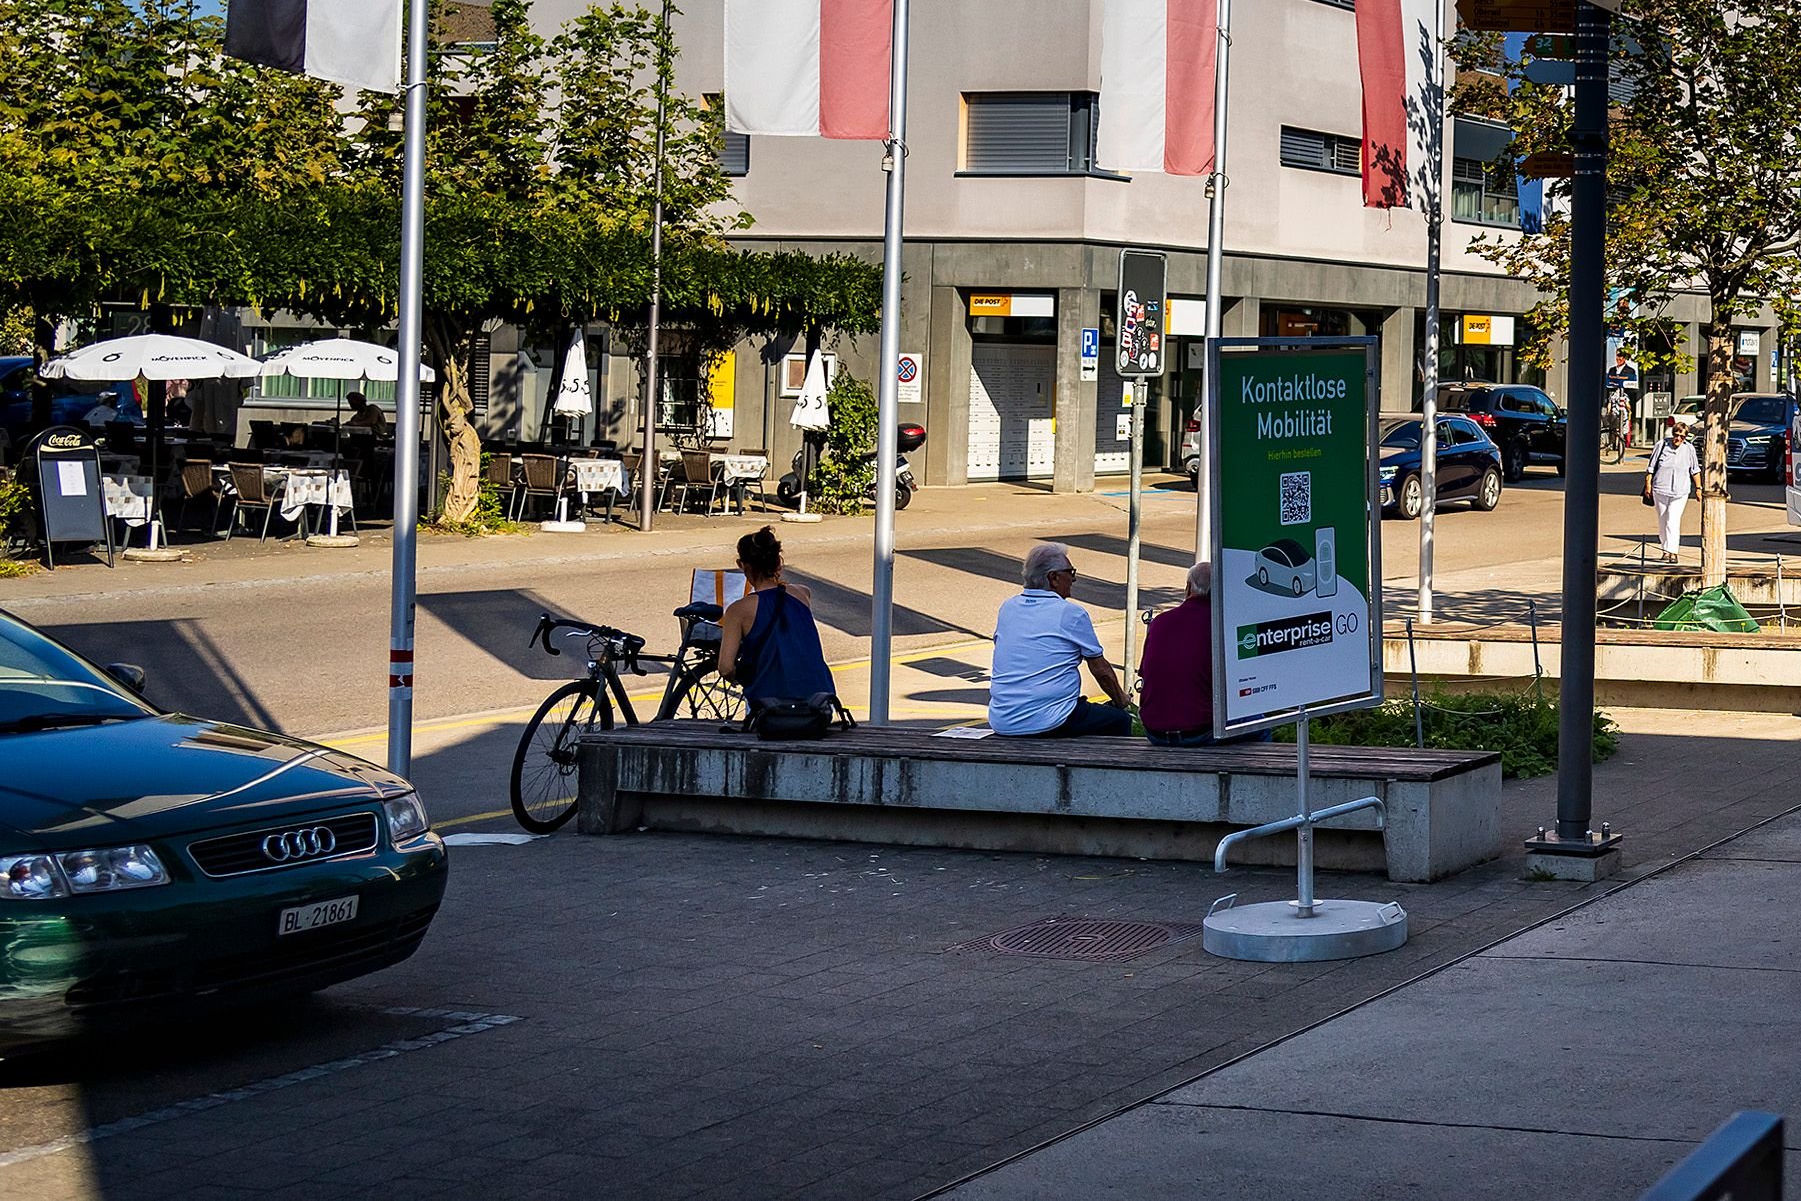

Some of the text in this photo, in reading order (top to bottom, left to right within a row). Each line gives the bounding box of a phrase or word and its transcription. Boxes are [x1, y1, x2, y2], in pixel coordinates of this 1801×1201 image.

[1535, 37, 1552, 49] 32
[1476, 322, 1486, 330] POST
[1084, 331, 1093, 354] P
[1242, 373, 1346, 403] Kontaktlose
[1257, 409, 1332, 439] Mobilität
[1267, 447, 1322, 461] Hierhin bestellen
[1238, 612, 1358, 649] enterprise GO
[1299, 635, 1331, 647] rent-a-car
[284, 900, 353, 931] BL 21861
